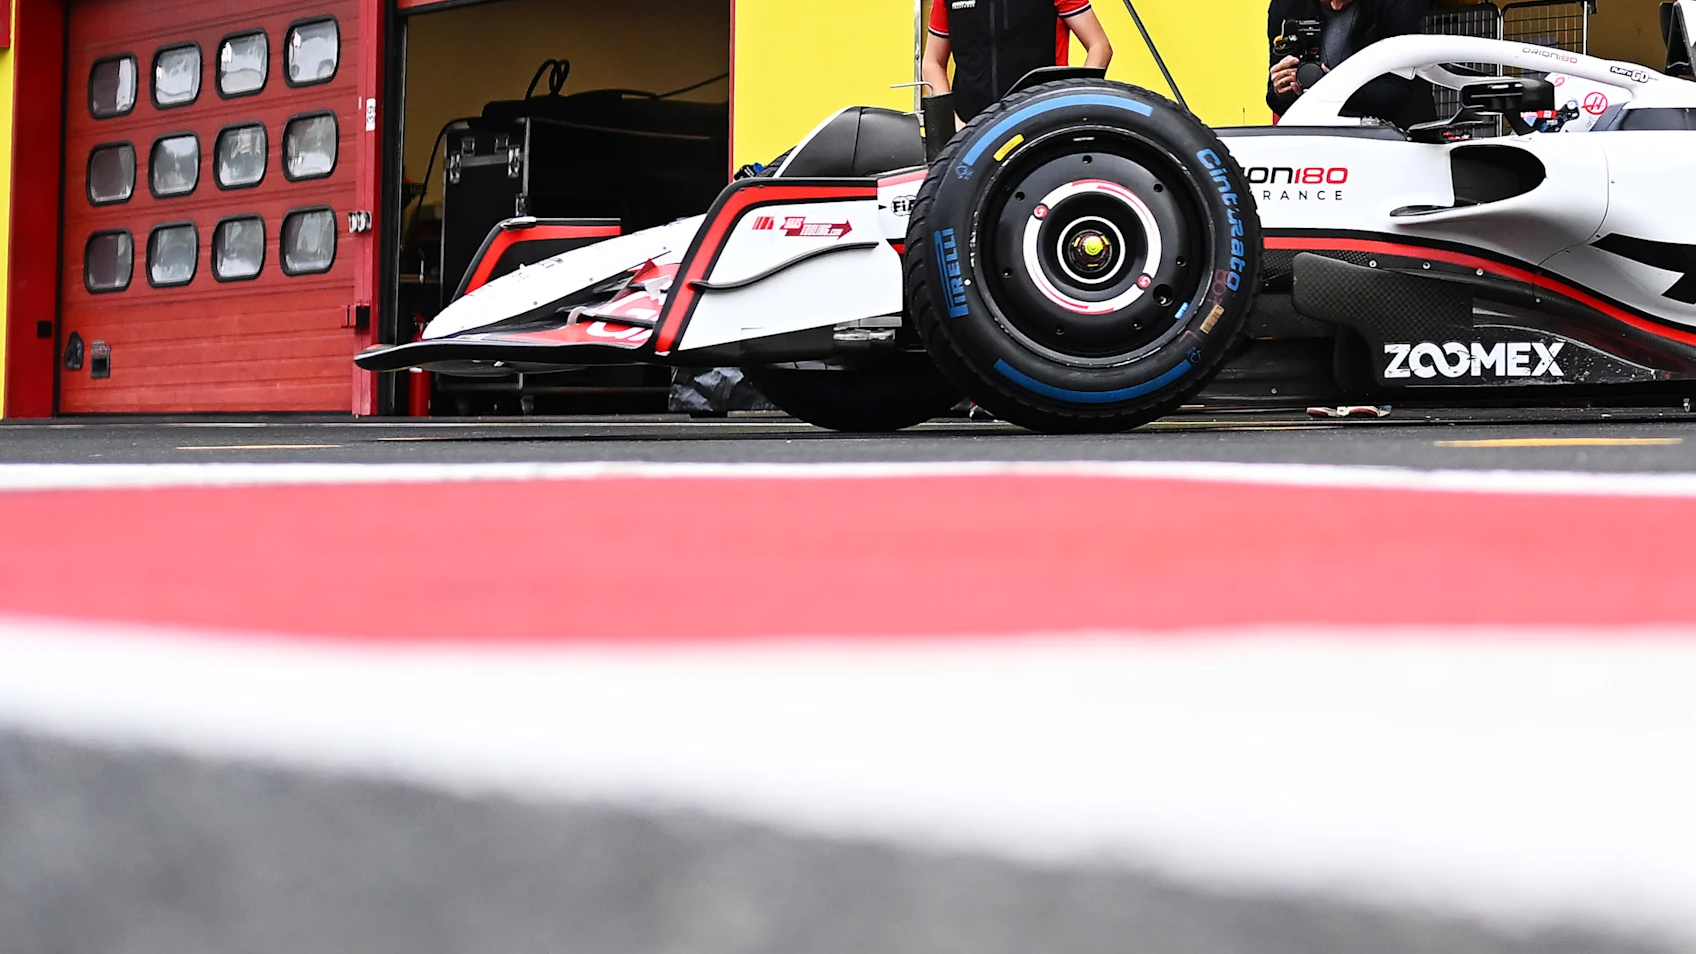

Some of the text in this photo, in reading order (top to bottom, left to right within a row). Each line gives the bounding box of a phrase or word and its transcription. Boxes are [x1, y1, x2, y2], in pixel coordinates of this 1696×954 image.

[1196, 148, 1246, 292] Cinturato
[934, 228, 969, 318] PIRELLI
[1384, 341, 1565, 379] ZOOMEX
